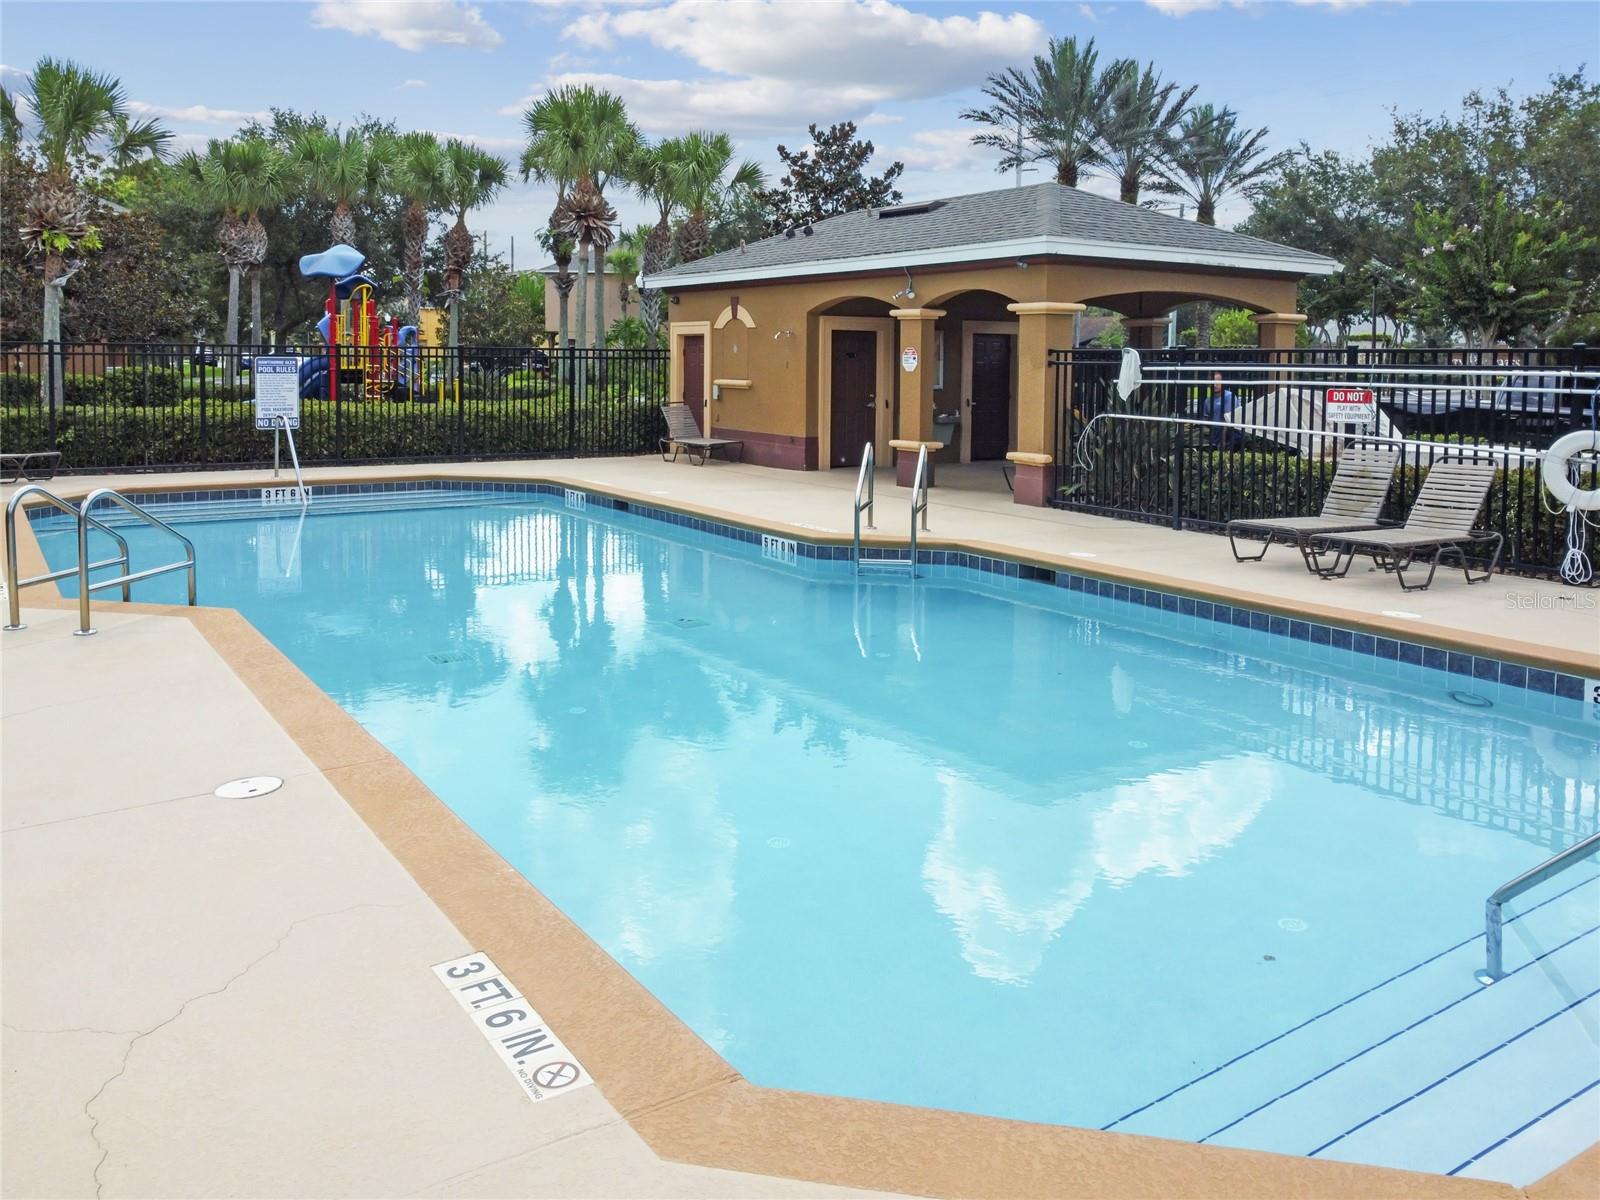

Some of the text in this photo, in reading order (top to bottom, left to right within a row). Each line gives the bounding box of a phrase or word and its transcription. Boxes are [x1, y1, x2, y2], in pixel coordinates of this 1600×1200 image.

[1333, 391, 1365, 401] DO NOT
[258, 419, 298, 427] NO DVNG
[265, 489, 271, 498] 3
[275, 489, 286, 498] FT
[290, 488, 296, 497] 6
[764, 537, 769, 548] 5
[770, 538, 778, 550] FT
[787, 542, 795, 554] IN
[446, 961, 555, 1065] 3 FT. 6 IN.
[516, 1068, 544, 1099] NO DIVING
